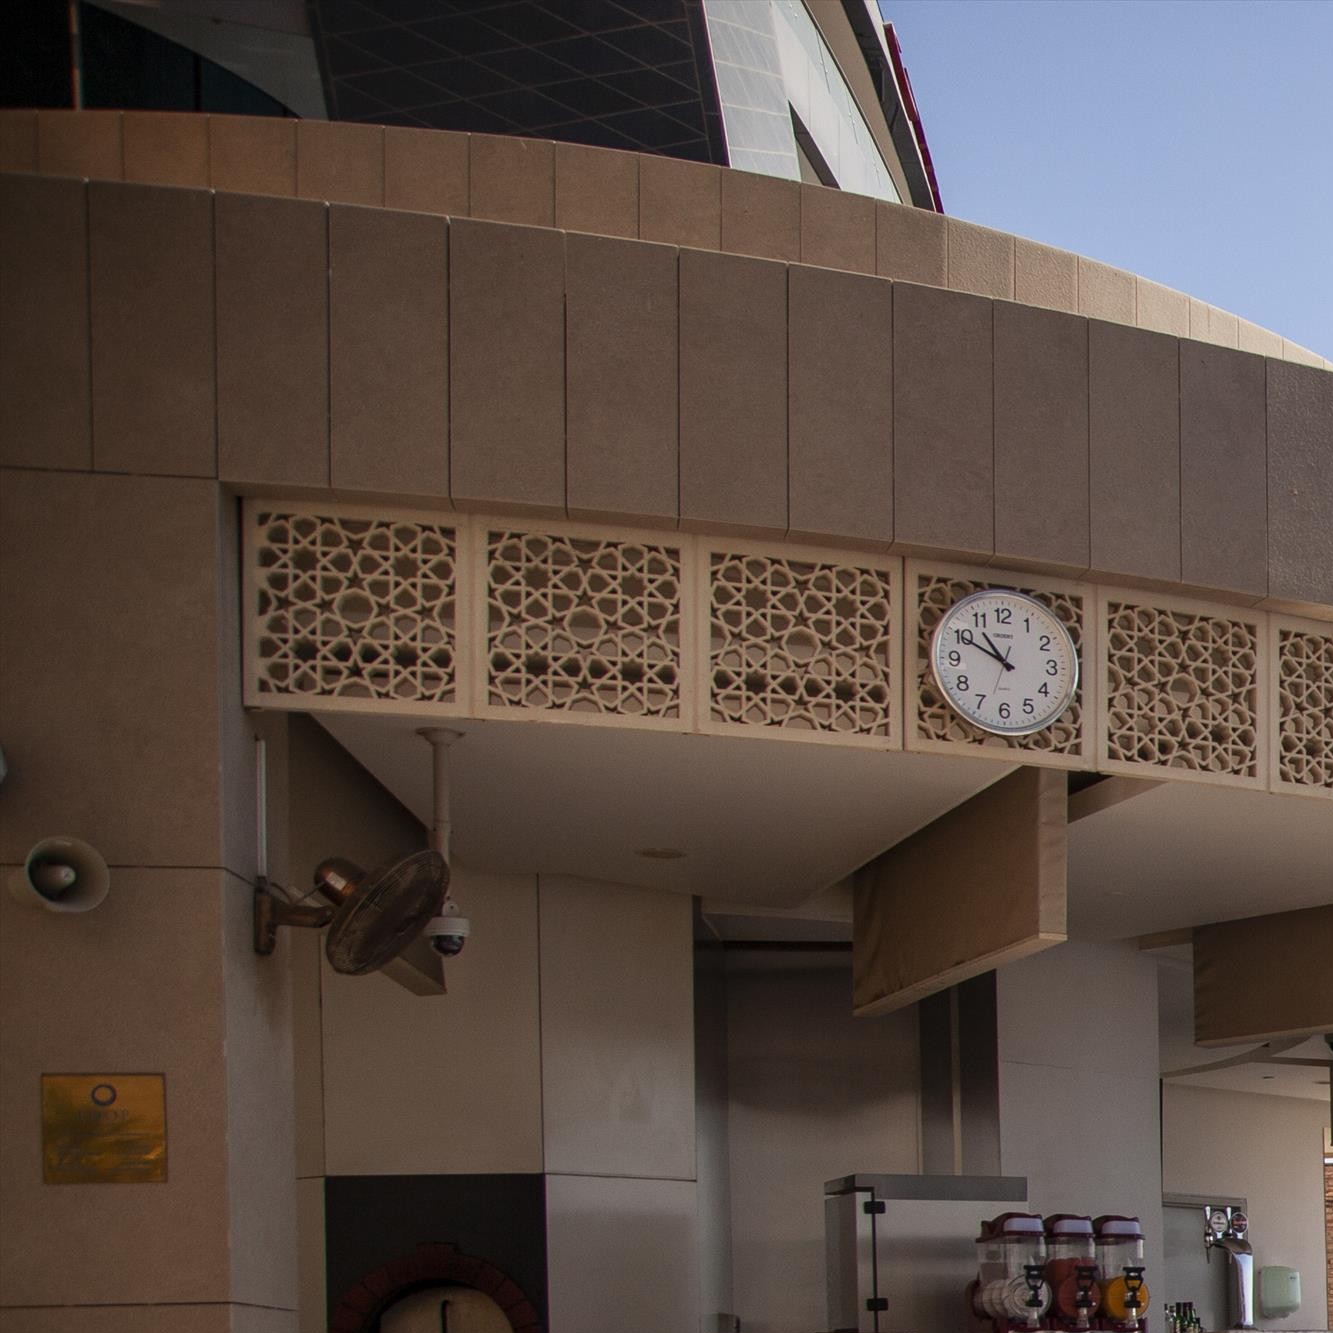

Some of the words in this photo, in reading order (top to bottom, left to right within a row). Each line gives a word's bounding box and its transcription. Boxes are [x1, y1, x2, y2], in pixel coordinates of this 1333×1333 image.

[972, 612, 987, 628] 11
[994, 608, 1012, 625] 12
[1023, 618, 1030, 633] 1
[954, 628, 973, 645] 10
[1039, 635, 1050, 651] 2
[948, 650, 961, 667] 9
[1046, 659, 1058, 676] 3
[956, 675, 969, 691] 8
[1038, 682, 1050, 697] 4
[974, 694, 986, 709] 7
[1023, 698, 1035, 714] 5
[999, 702, 1010, 719] 6
